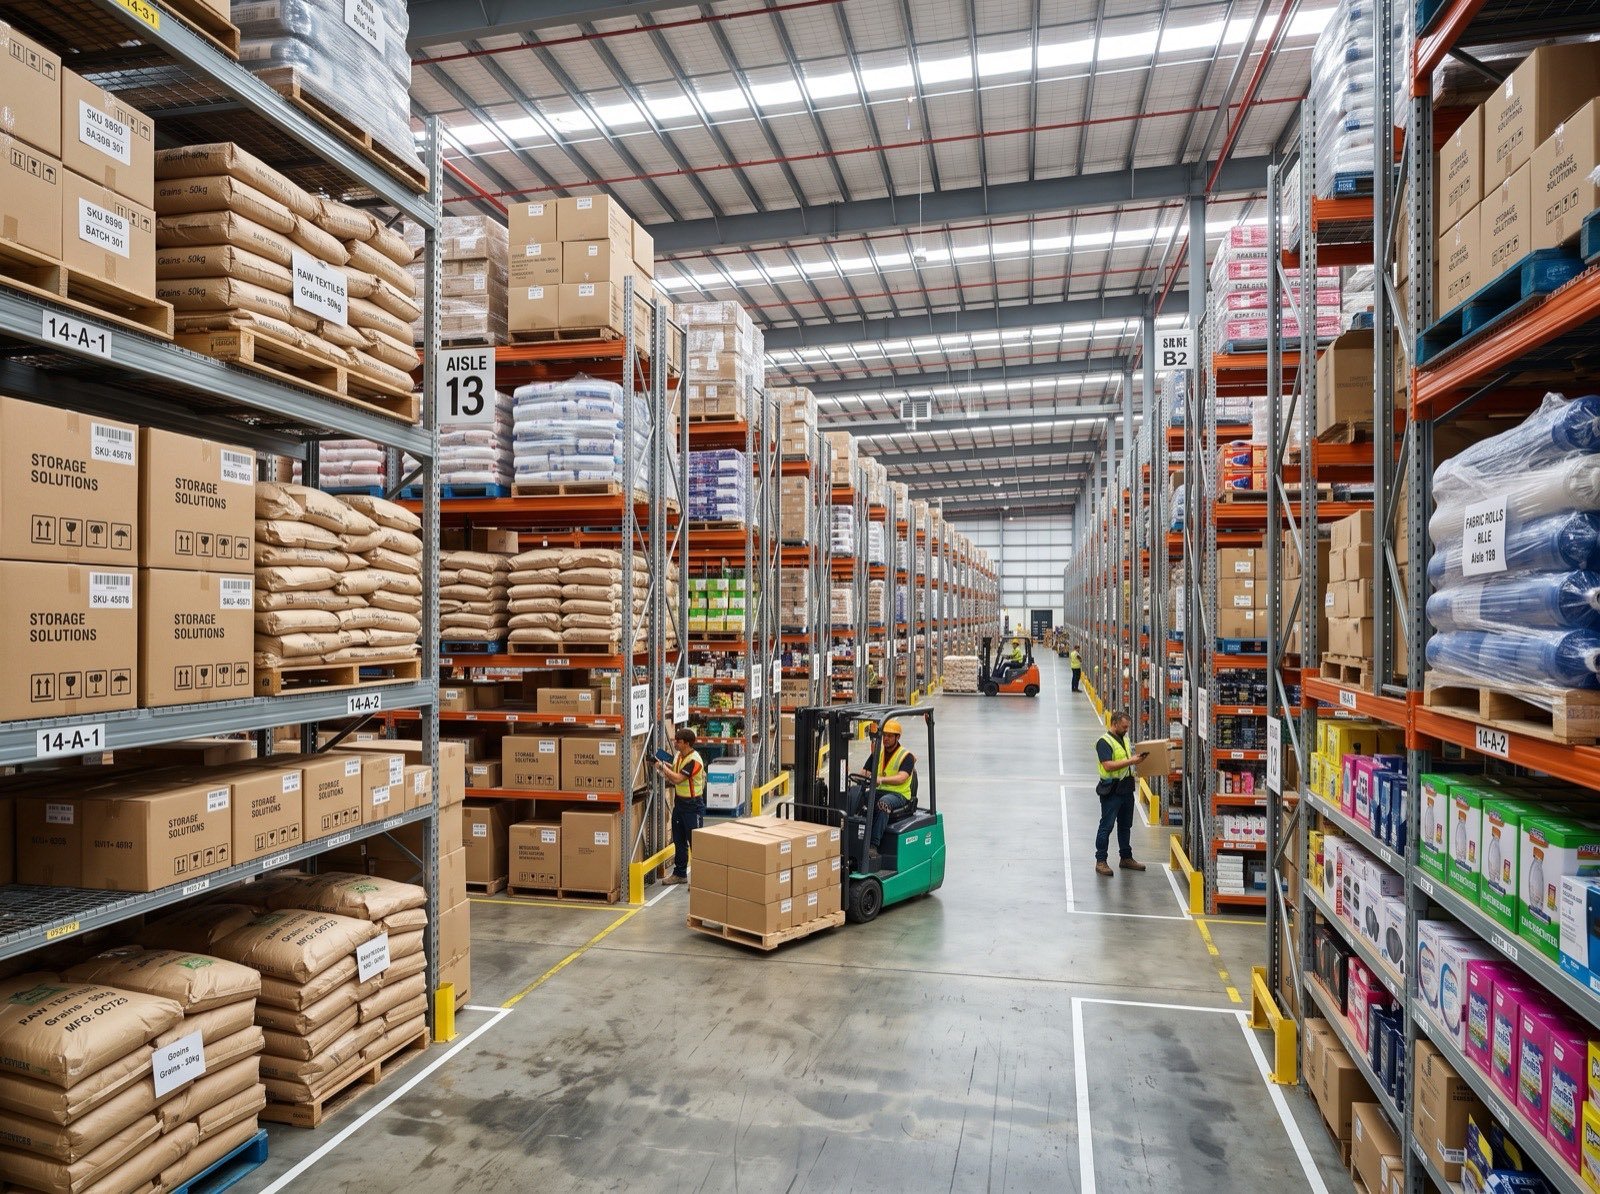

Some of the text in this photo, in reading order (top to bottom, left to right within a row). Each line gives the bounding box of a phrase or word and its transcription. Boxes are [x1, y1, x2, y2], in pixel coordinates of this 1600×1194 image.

[86, 108, 103, 125] SKU
[112, 141, 124, 155] 301
[1549, 154, 1574, 179] STORAGE
[1547, 163, 1577, 192] SOLUTIONS
[86, 206, 103, 221] SKU
[85, 224, 124, 249] BATCH 301
[297, 268, 345, 297] RAW TEXTILES
[300, 286, 323, 303] Grains
[48, 317, 106, 353] 14-A-1
[446, 355, 487, 371] AISLE
[1163, 351, 1188, 366] B2
[446, 375, 484, 416] 13
[31, 453, 87, 474] STORAGE
[31, 469, 99, 491] SOLUTIONS
[175, 477, 218, 495] STORAGE
[175, 492, 227, 510] SOLUTIONS
[1466, 508, 1504, 530] FABRIC ROLLS
[1471, 551, 1484, 564] Aisle
[30, 612, 86, 626] STORAGE
[174, 613, 216, 626] STORAGE
[30, 628, 97, 643] SOLUTIONS
[174, 627, 225, 640] SOLUTIONS
[350, 695, 379, 712] 14-A-2
[677, 695, 685, 709] 14
[636, 704, 644, 719] 12
[42, 728, 99, 752] 14-A-1
[1478, 729, 1506, 753] 14-A-2
[1270, 745, 1278, 777] 13
[318, 779, 340, 791] STORAGE
[318, 787, 344, 800] SOLUTIONS
[251, 796, 276, 809] STORAGE
[251, 804, 281, 818] SOLUTIONS
[168, 814, 199, 829] STORAGE
[168, 822, 205, 839] SOLUTIONS
[18, 1008, 48, 1026] RAW
[44, 1004, 83, 1026] Grains
[64, 996, 129, 1033] MFG: OCT23
